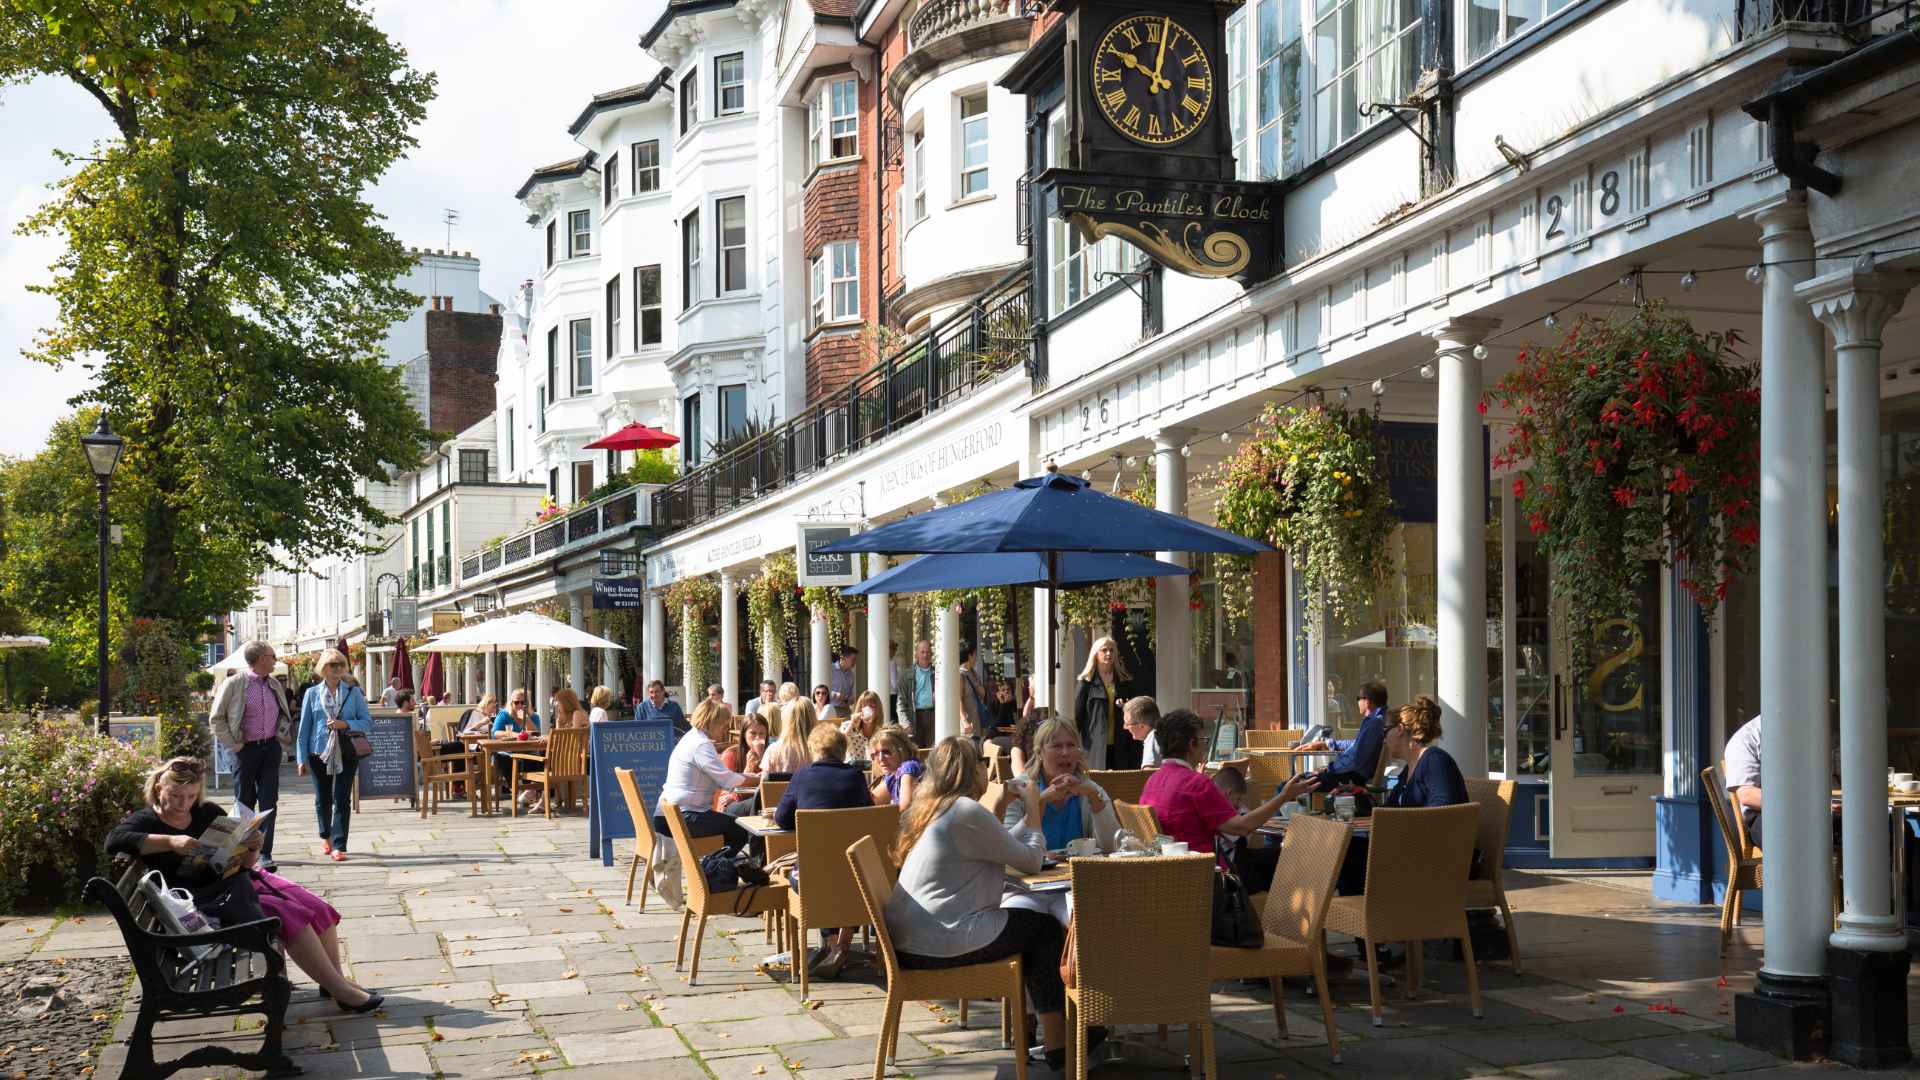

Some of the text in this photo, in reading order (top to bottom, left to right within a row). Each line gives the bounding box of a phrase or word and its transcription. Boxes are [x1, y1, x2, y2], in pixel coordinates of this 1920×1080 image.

[1122, 26, 1141, 49] XI
[1145, 23, 1160, 43] XII
[1169, 32, 1181, 49] I
[1181, 52, 1200, 68] II
[1101, 68, 1121, 83] IX
[1187, 77, 1206, 90] III
[1105, 88, 1127, 113] VIII
[1123, 105, 1141, 130] VII
[1147, 114, 1163, 135] VI
[1171, 112, 1185, 132] V
[1060, 185, 1270, 220] The Pantiles Clock
[937, 422, 1003, 471] HUNGERFORD
[808, 553, 844, 563] CAKE
[809, 562, 840, 574] SHED
[594, 582, 639, 593] White Room
